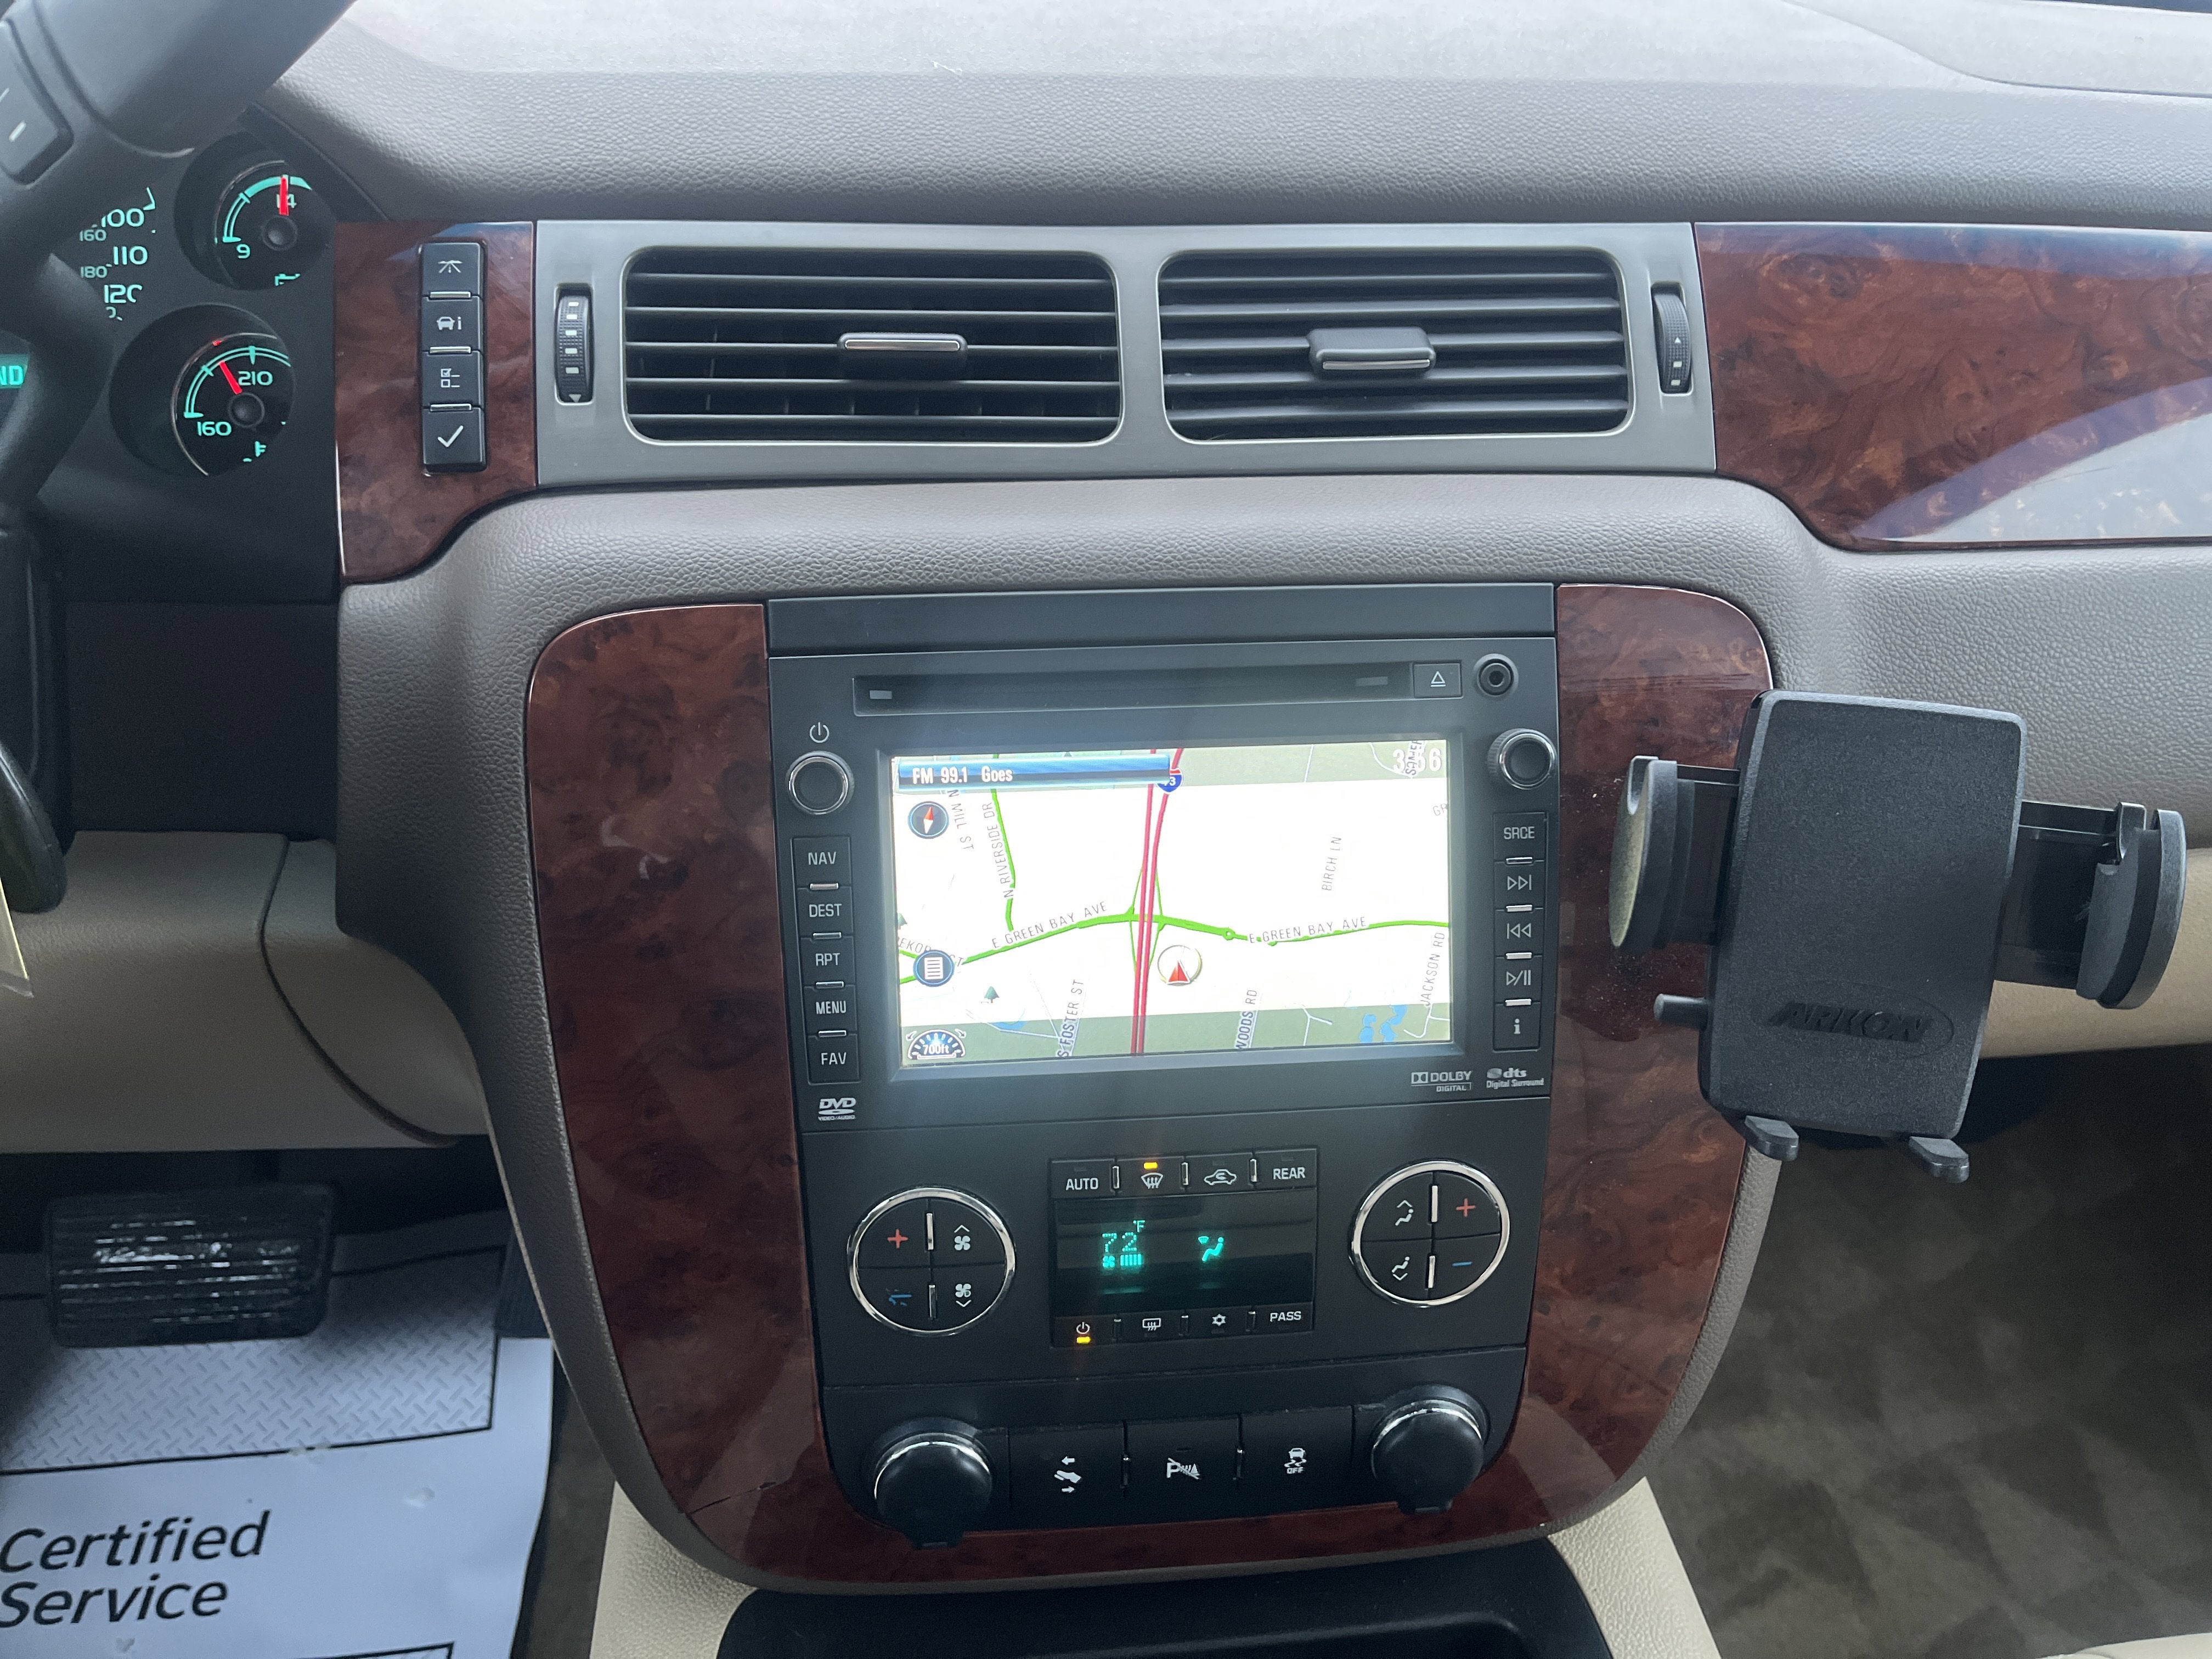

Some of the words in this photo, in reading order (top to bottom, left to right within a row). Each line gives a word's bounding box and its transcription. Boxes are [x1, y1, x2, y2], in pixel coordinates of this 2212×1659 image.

[101, 208, 145, 227] 100
[80, 229, 107, 241] 160
[113, 246, 148, 265] 110
[236, 244, 251, 258] 9
[81, 266, 108, 278] 180
[238, 371, 273, 386] 210
[197, 421, 232, 436] 160
[912, 768, 934, 785] FM
[940, 766, 968, 783] 99.1
[981, 765, 1013, 782] Goes
[982, 802, 995, 819] DR
[951, 803, 967, 829] MILL
[960, 836, 974, 849] ST
[1503, 826, 1535, 840] SRCE
[808, 852, 837, 865] NAV
[987, 824, 1011, 884] RIVERSIDE
[1322, 857, 1338, 891] BIRCH
[1331, 837, 1342, 851] LN
[1003, 889, 1014, 898] N
[809, 903, 842, 917] DEST
[992, 938, 999, 949] E
[1005, 923, 1044, 946] GREEN
[1049, 913, 1075, 929] BAY
[1084, 901, 1107, 919] AVE
[1249, 933, 1256, 944] E
[1262, 926, 1301, 942] GREEN
[1308, 922, 1334, 935] BAY
[1342, 916, 1367, 930] AVE
[816, 953, 840, 967] RPT
[1420, 954, 1440, 1006] JACKSON
[1433, 933, 1445, 947] RD
[1245, 990, 1257, 1005] RD
[816, 1001, 847, 1014] MENU
[1059, 1002, 1079, 1045] FOSTER
[1070, 979, 1084, 995] ST
[1768, 1001, 1932, 1043] ARKON
[923, 1043, 950, 1055] 700ft
[821, 1052, 847, 1065] FAV
[1430, 1070, 1472, 1082] DOLBY
[1503, 1068, 1527, 1078] dts
[1436, 1084, 1466, 1092] DIGITAL
[819, 1097, 856, 1109] DVD
[1273, 1166, 1306, 1180] REAR
[1065, 1177, 1099, 1191] AUTO
[1102, 1232, 1137, 1252] 72
[1269, 1310, 1302, 1322] PASS
[0, 1510, 272, 1572] Certified
[0, 1573, 228, 1628] Service
